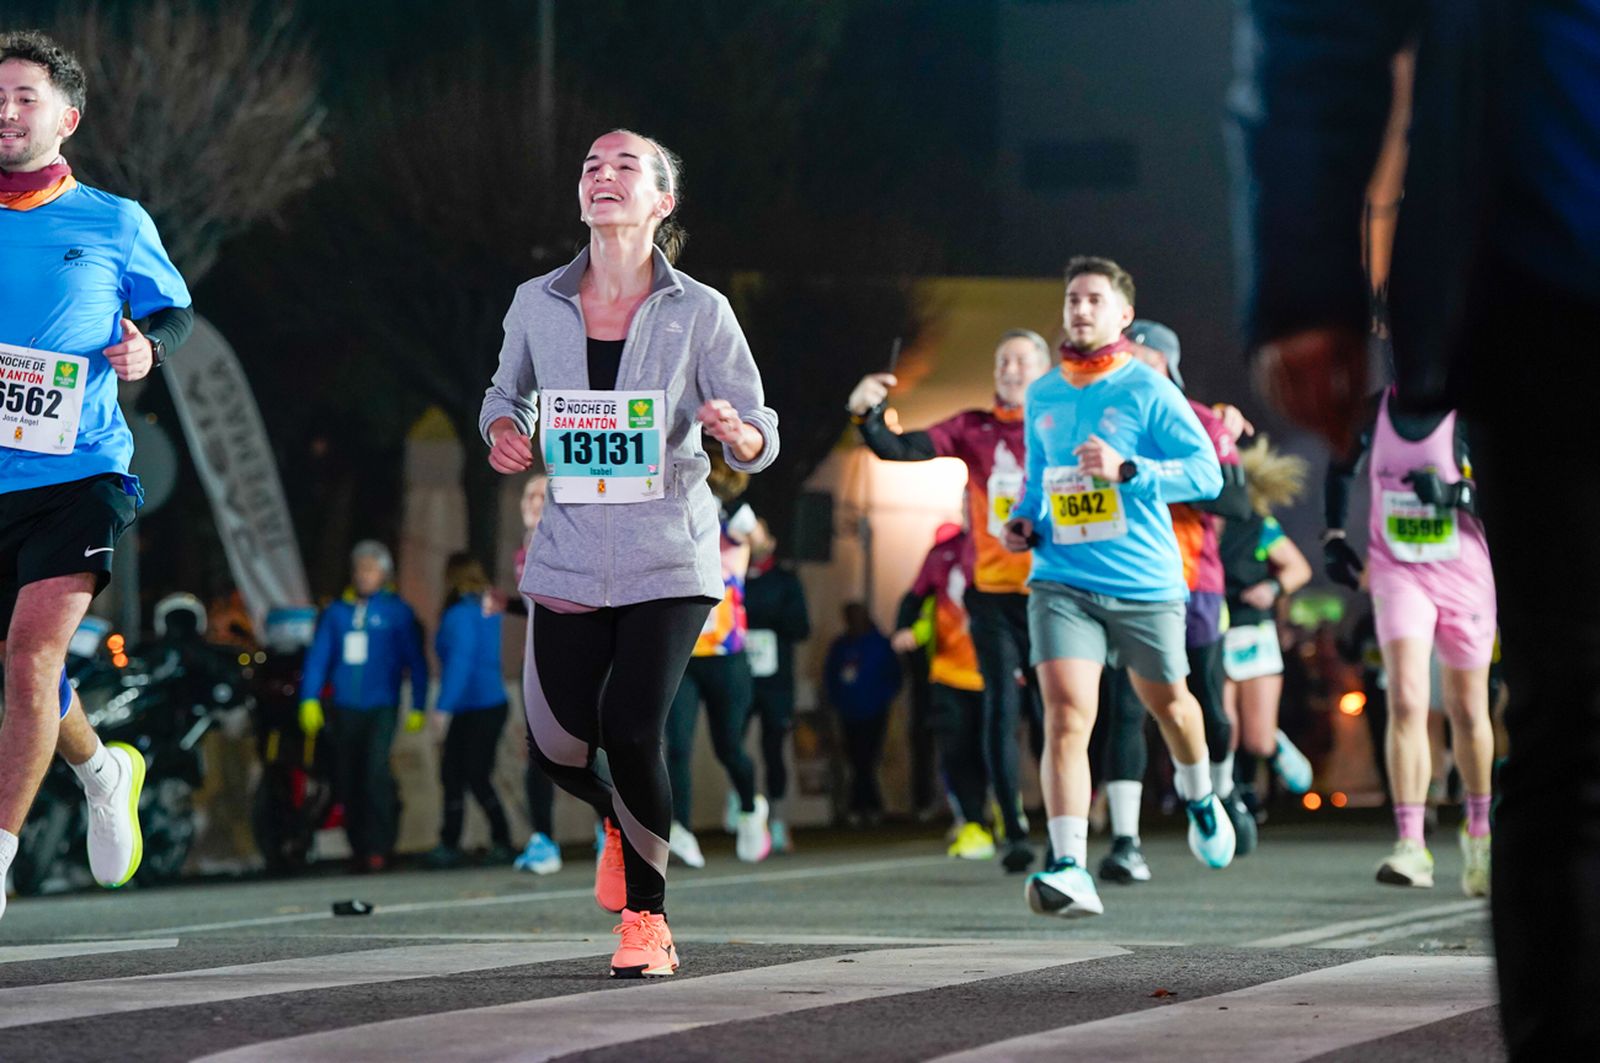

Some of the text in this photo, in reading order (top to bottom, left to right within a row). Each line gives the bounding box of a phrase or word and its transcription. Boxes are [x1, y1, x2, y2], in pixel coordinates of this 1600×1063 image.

[33, 361, 46, 372] DE
[7, 370, 44, 385] ANTÓN
[567, 403, 617, 415] NOCHE DE
[554, 416, 576, 429] SAN
[577, 414, 617, 429] ANTÓN
[558, 431, 645, 465] 13131
[590, 467, 613, 476] Isabel
[1059, 492, 1106, 517] 3642
